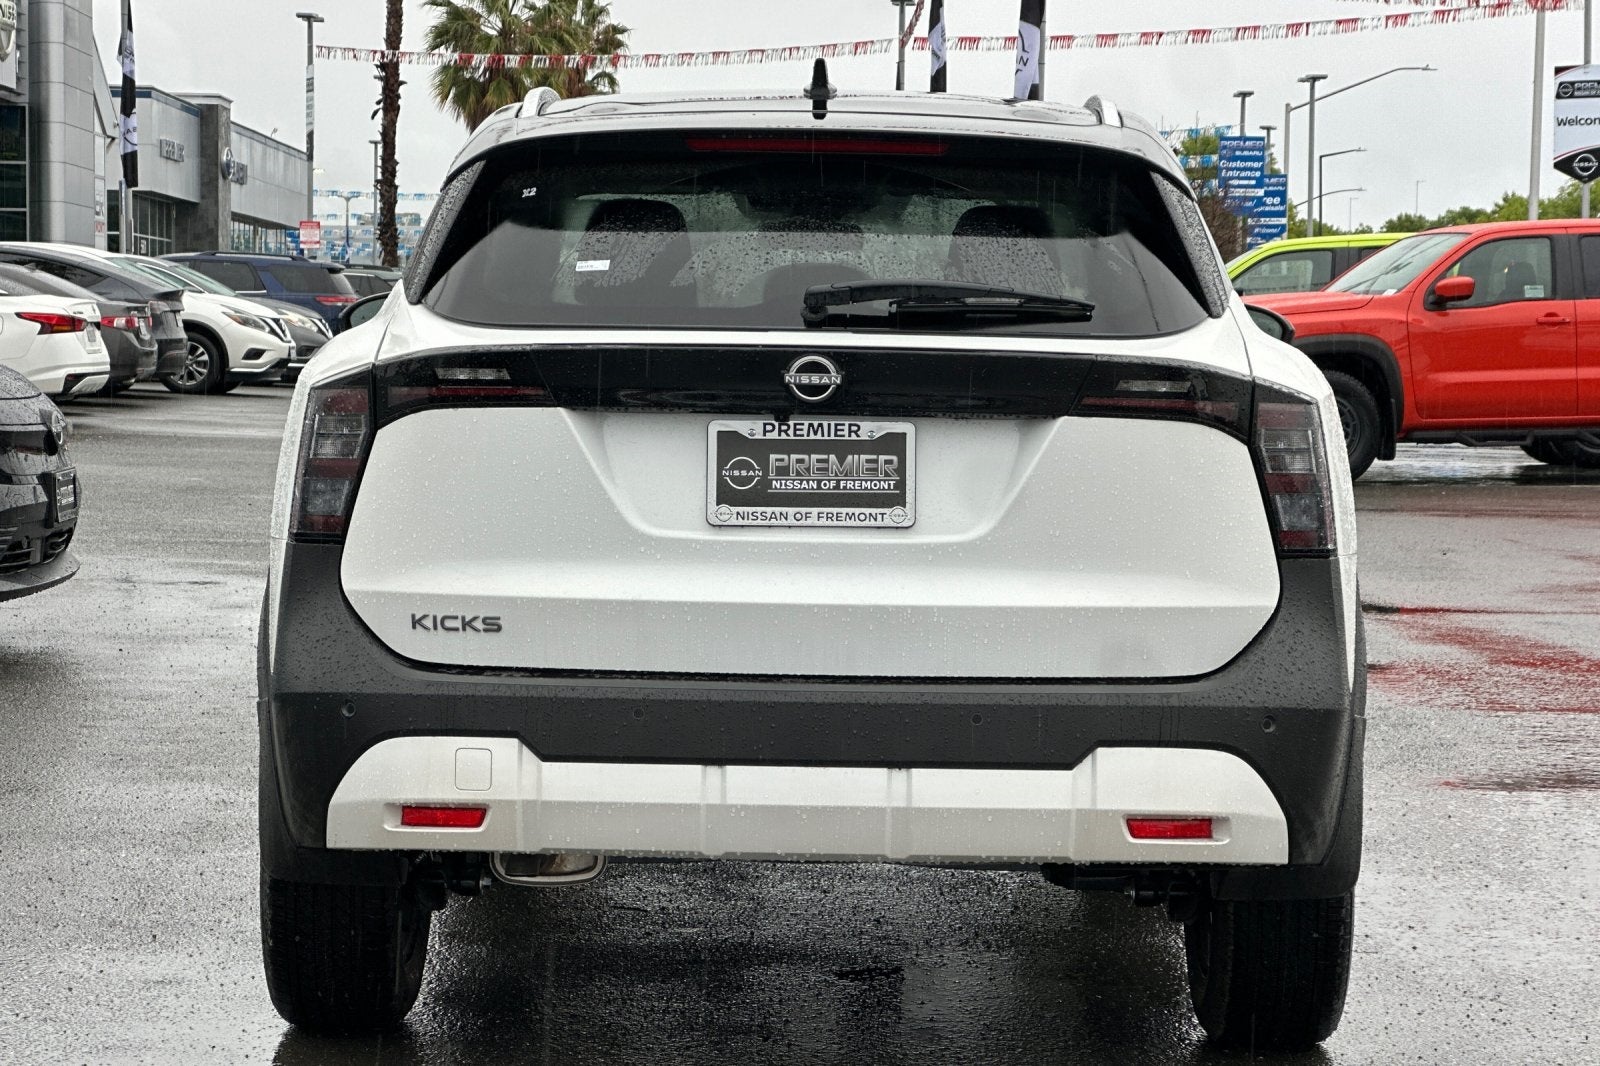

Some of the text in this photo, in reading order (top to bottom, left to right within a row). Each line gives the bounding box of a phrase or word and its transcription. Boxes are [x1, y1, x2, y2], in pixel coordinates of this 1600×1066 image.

[1220, 159, 1264, 168] Customer
[1221, 169, 1261, 177] Entrance
[785, 375, 841, 384] NISSAN
[762, 422, 861, 438] PREMIER
[769, 453, 900, 477] PREMIER
[722, 469, 762, 477] NISSAN
[771, 480, 896, 490] NISSAN OF FREMONT
[735, 510, 789, 522] NISSAN
[793, 511, 815, 523] OF
[816, 511, 887, 523] FREMONT
[411, 613, 503, 633] KICKS
